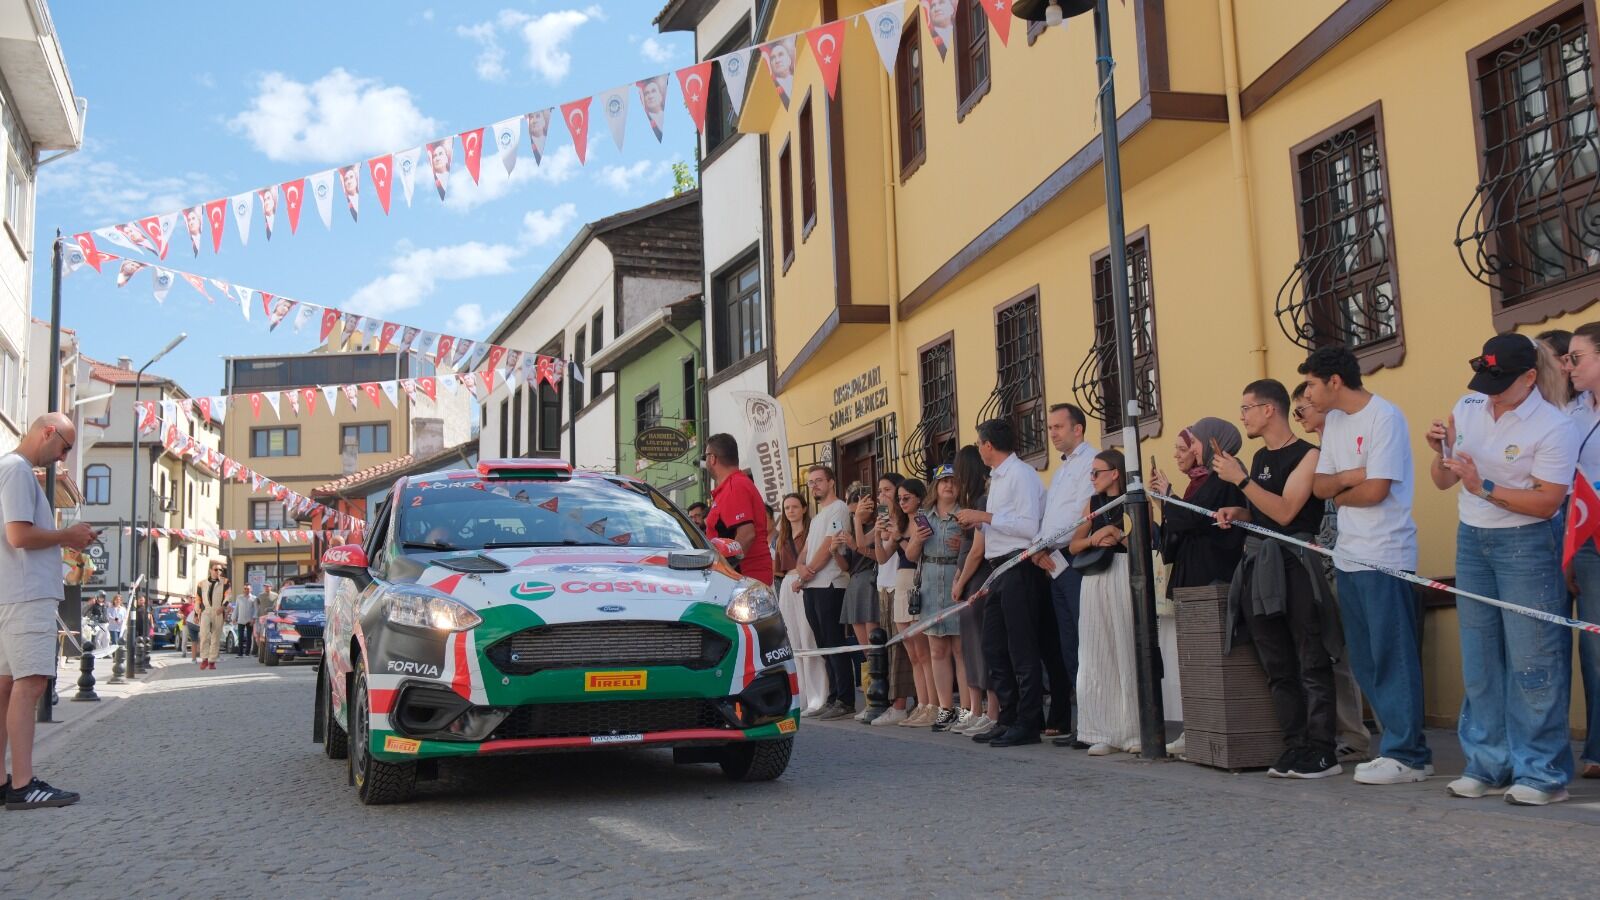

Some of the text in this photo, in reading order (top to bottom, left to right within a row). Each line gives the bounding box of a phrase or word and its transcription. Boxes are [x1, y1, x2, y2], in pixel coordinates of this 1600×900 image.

[411, 496, 424, 508] 2
[323, 549, 351, 563] NGK
[560, 580, 694, 596] Castrol
[387, 660, 439, 676] FORVIA
[590, 674, 642, 688] PIRELLI
[386, 738, 419, 753] PIRELLI
